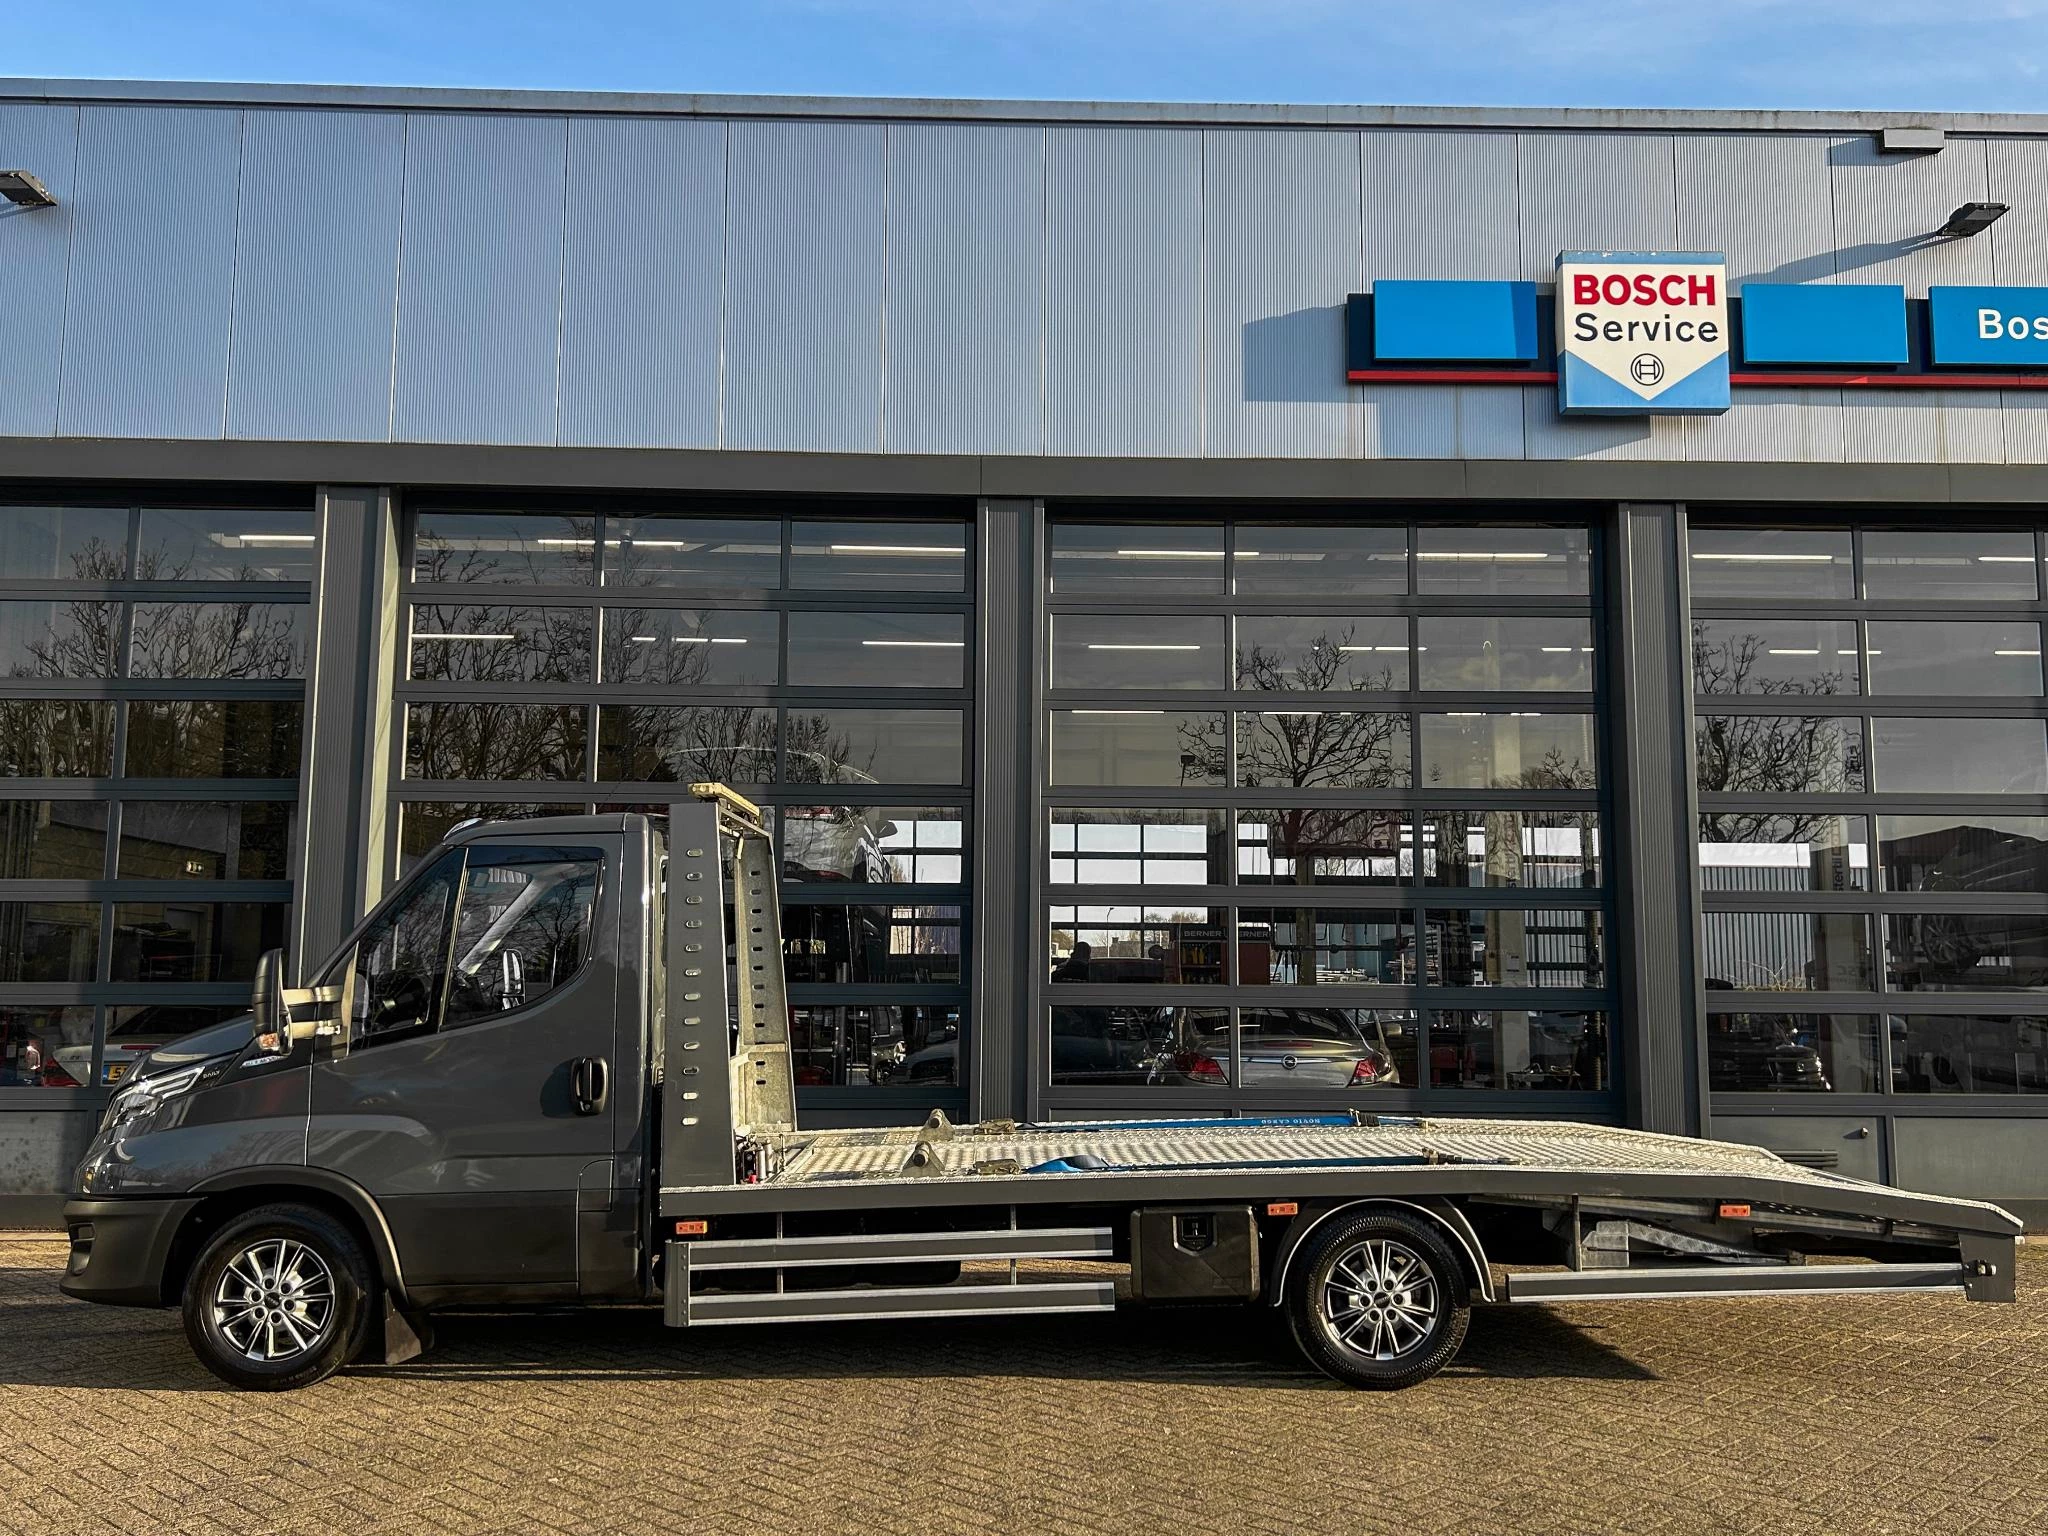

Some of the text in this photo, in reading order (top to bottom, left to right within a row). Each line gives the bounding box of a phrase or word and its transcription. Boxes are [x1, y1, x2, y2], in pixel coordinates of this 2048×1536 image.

[1574, 274, 1716, 306] BOSCH
[1574, 312, 1719, 342] Service
[1978, 308, 2048, 340] Bos
[202, 1069, 221, 1079] DAILY
